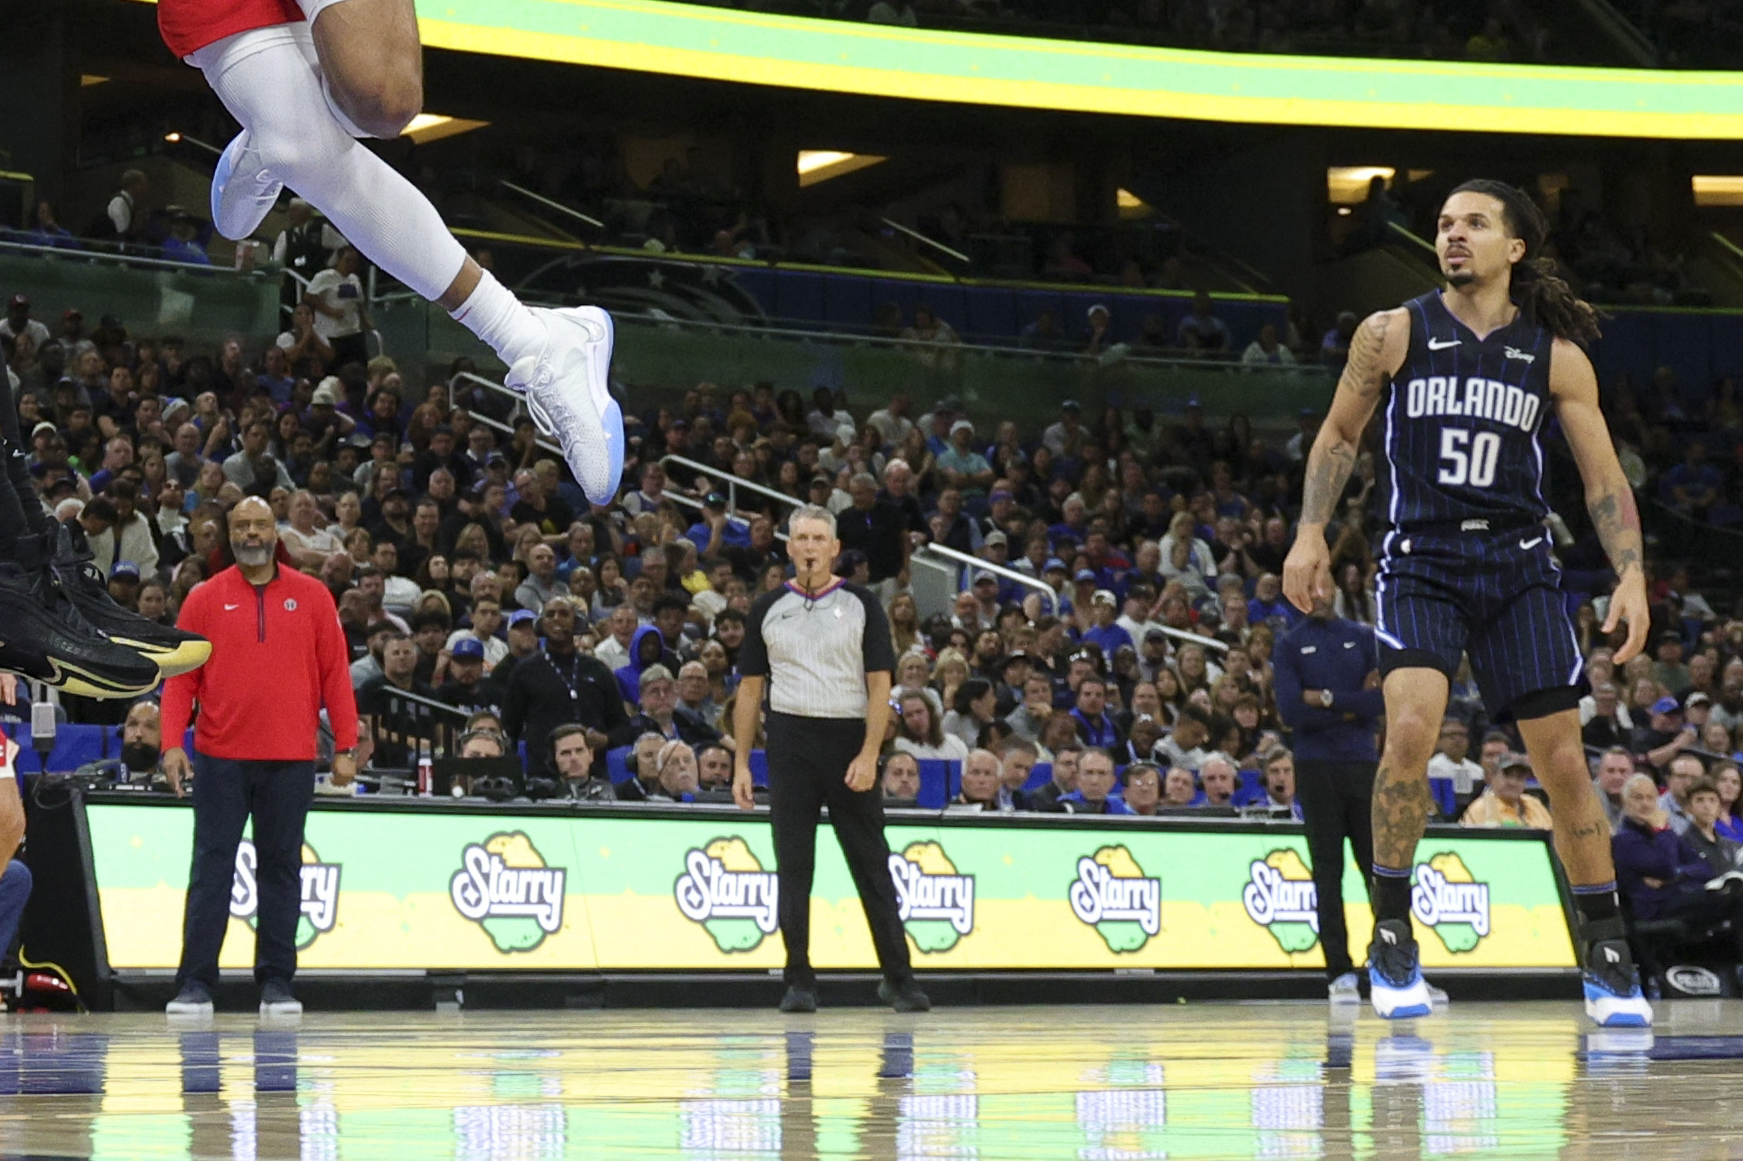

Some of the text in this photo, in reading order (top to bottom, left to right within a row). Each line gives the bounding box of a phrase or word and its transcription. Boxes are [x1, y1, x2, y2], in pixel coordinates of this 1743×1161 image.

[1504, 345, 1536, 364] Disney
[1407, 376, 1540, 432] ORLANDO
[1438, 427, 1501, 487] 50
[452, 845, 564, 932] Starry
[675, 849, 779, 934] Starry
[1069, 856, 1161, 935] Starry
[1411, 863, 1490, 937] Starry
